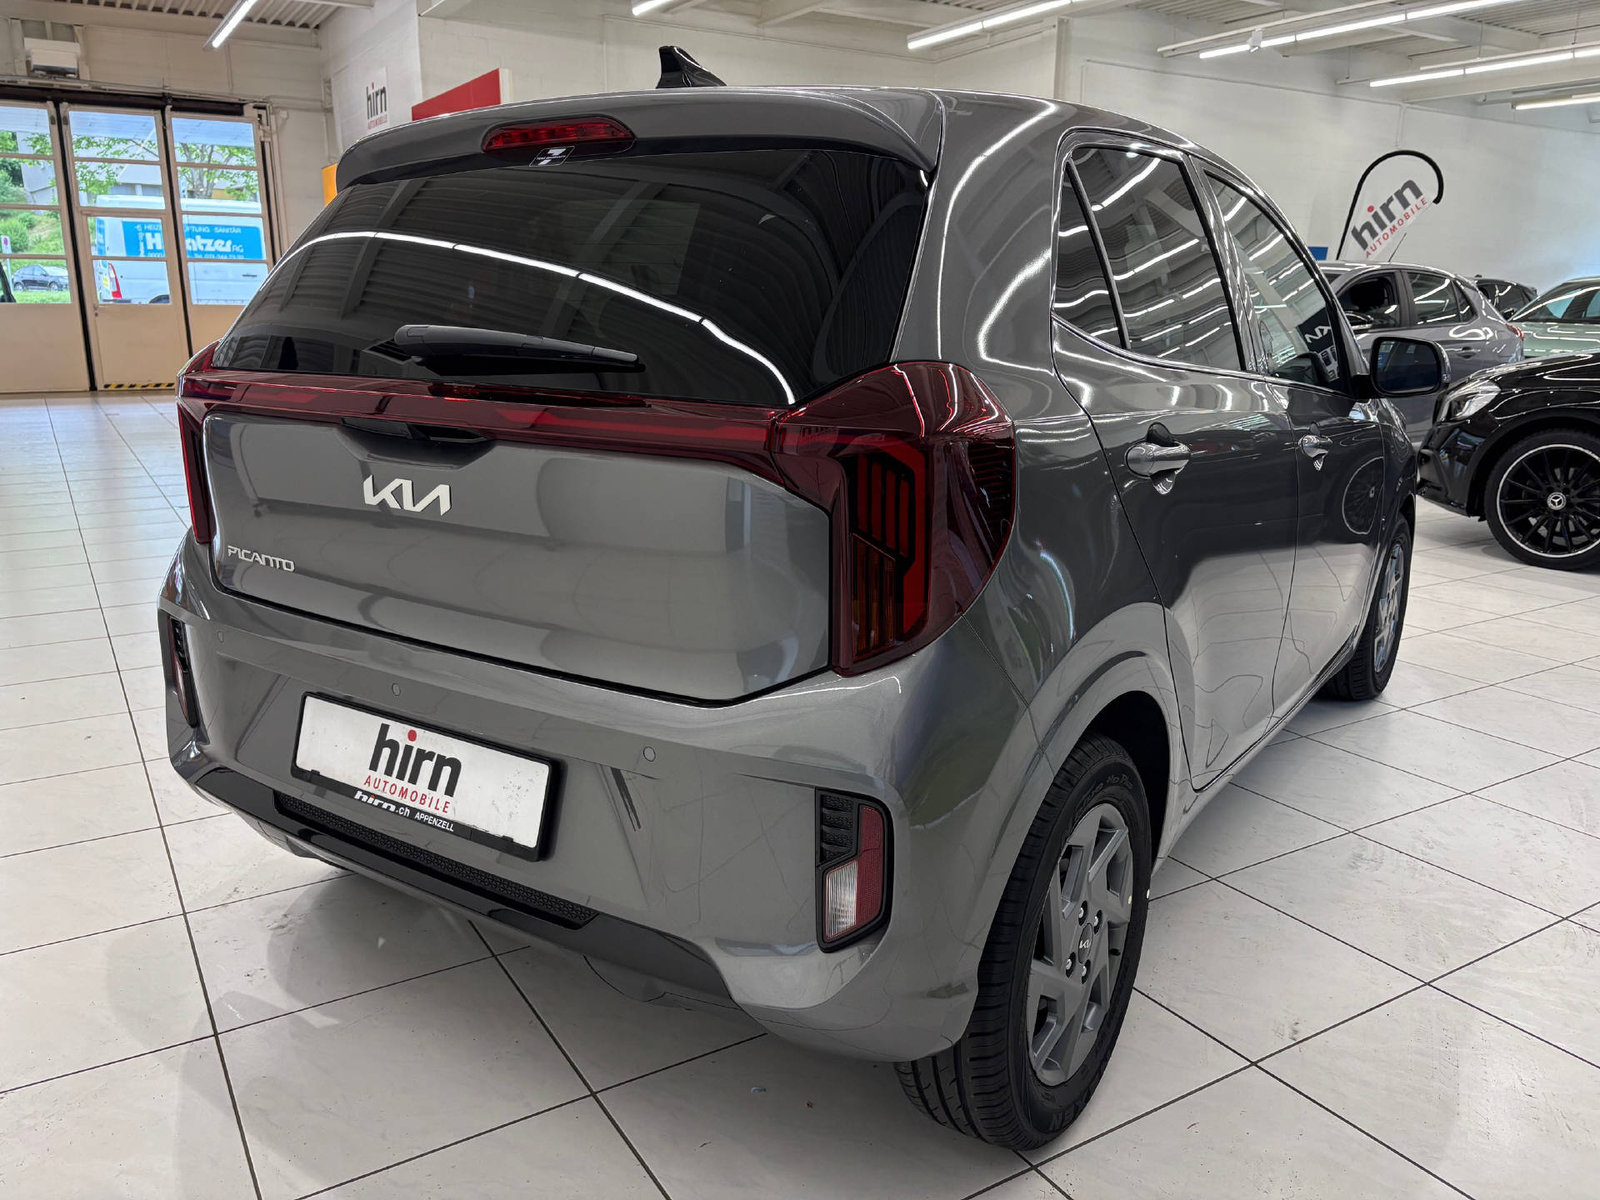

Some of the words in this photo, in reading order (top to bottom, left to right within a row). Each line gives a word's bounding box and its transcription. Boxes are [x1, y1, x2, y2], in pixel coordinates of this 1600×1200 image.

[366, 82, 387, 120] hirn
[1351, 179, 1423, 251] hirn
[1365, 197, 1427, 258] AUTOMOBILE
[363, 474, 451, 516] KIA
[227, 545, 295, 572] PICANTO
[369, 723, 462, 798] hirn
[354, 790, 410, 818] hirn.ch
[414, 812, 454, 832] APPENZELL
[363, 774, 451, 814] AUTOMOBILE
